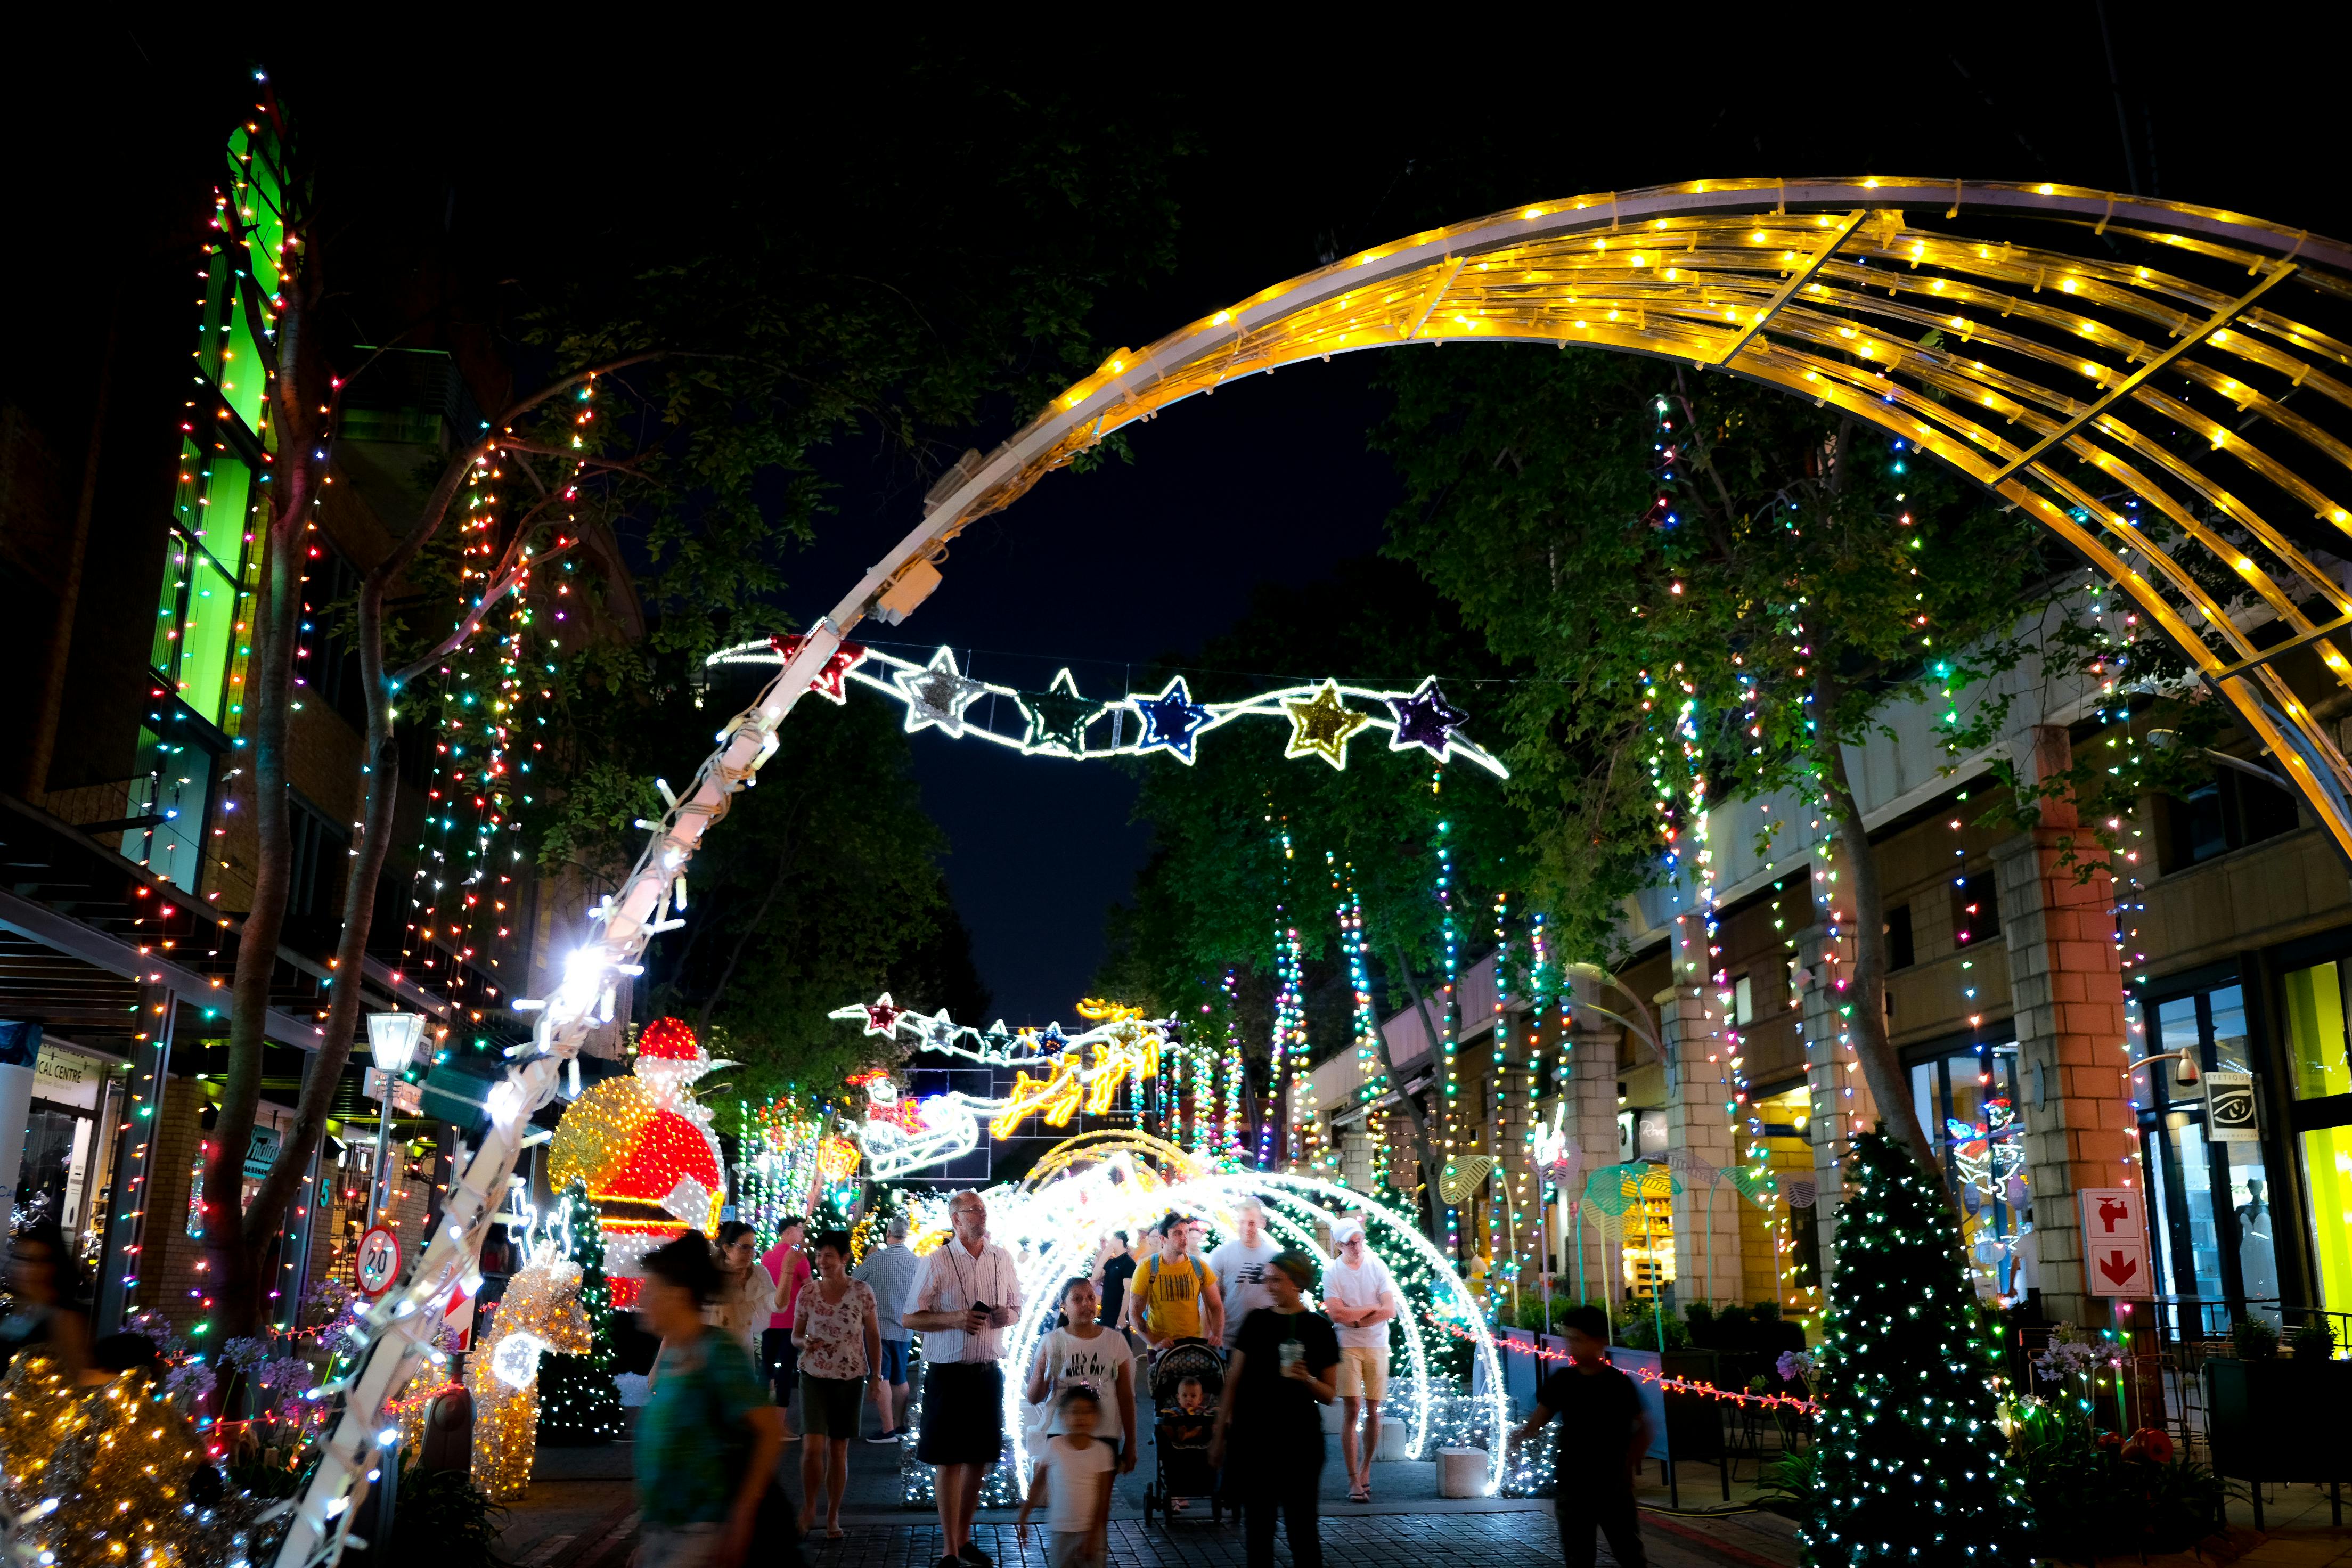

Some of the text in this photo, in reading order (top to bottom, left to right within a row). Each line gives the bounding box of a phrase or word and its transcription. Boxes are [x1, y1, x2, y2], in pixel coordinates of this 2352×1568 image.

[54, 1065, 82, 1083] CENTRE
[320, 1178, 331, 1207] 5
[365, 1248, 387, 1274] 20
